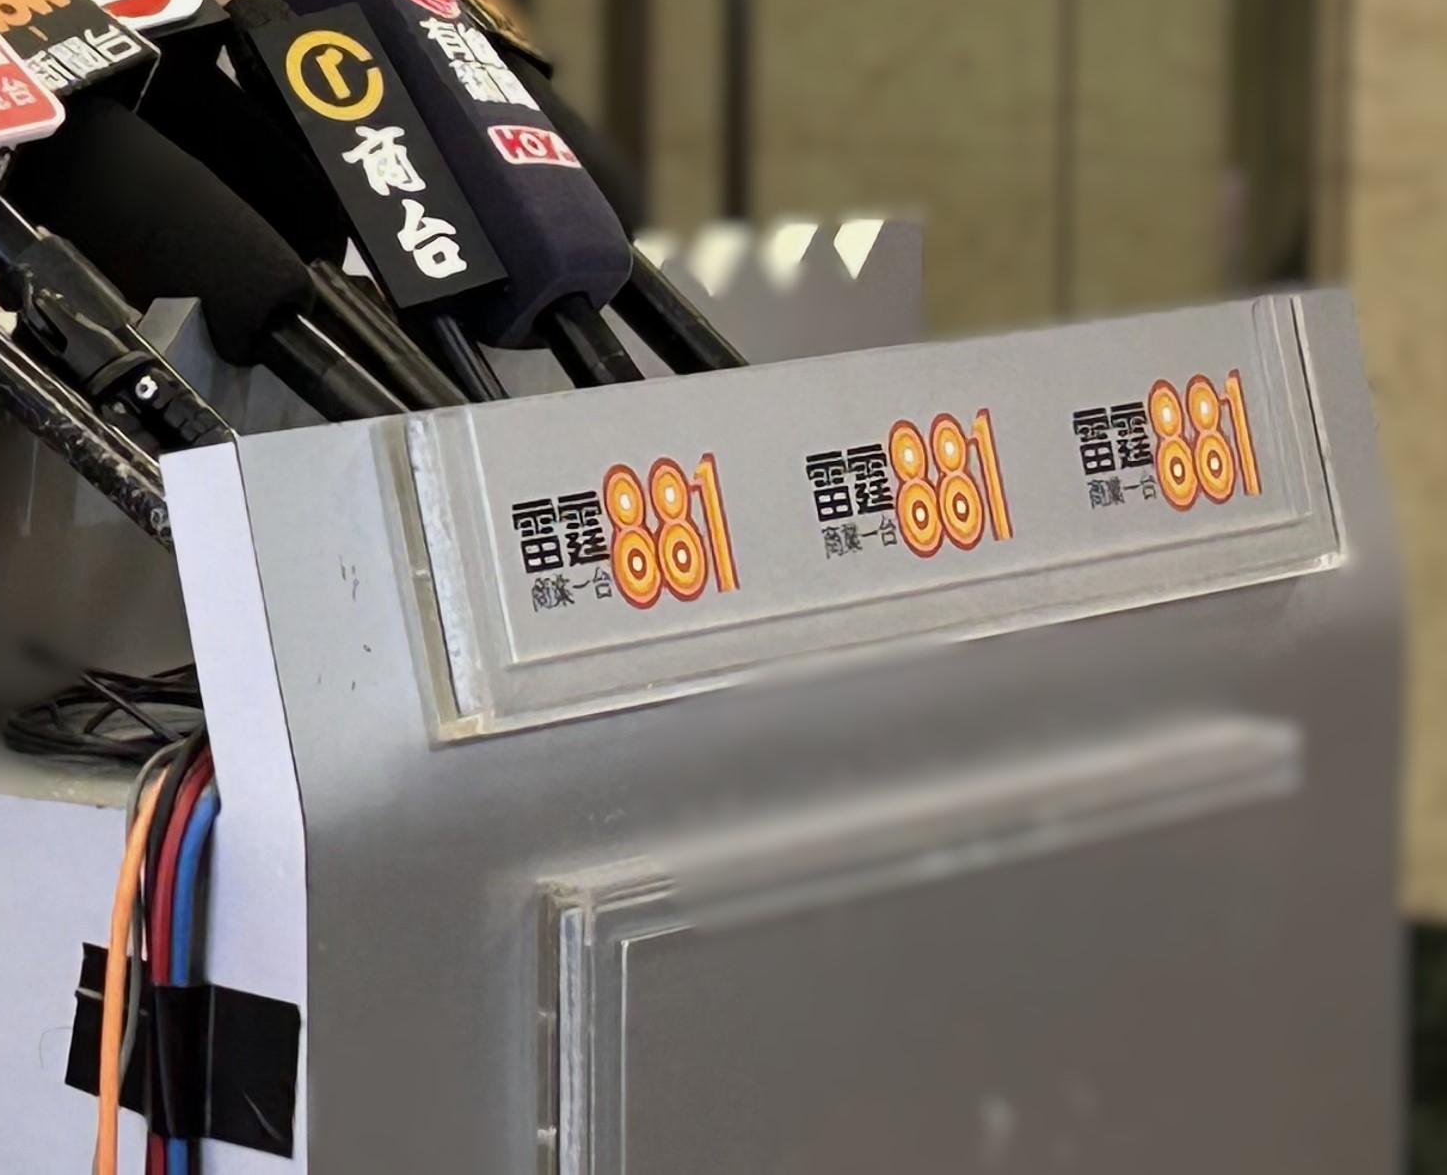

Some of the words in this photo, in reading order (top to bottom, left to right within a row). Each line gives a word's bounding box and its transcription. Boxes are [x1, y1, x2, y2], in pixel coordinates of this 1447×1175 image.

[341, 125, 468, 279] 商台
[805, 443, 896, 523] 雷霆
[888, 406, 1014, 559] 881
[1072, 400, 1155, 476] 雷霆
[1147, 367, 1263, 514] 881
[511, 489, 611, 575] 雷霆
[602, 451, 741, 611] 881
